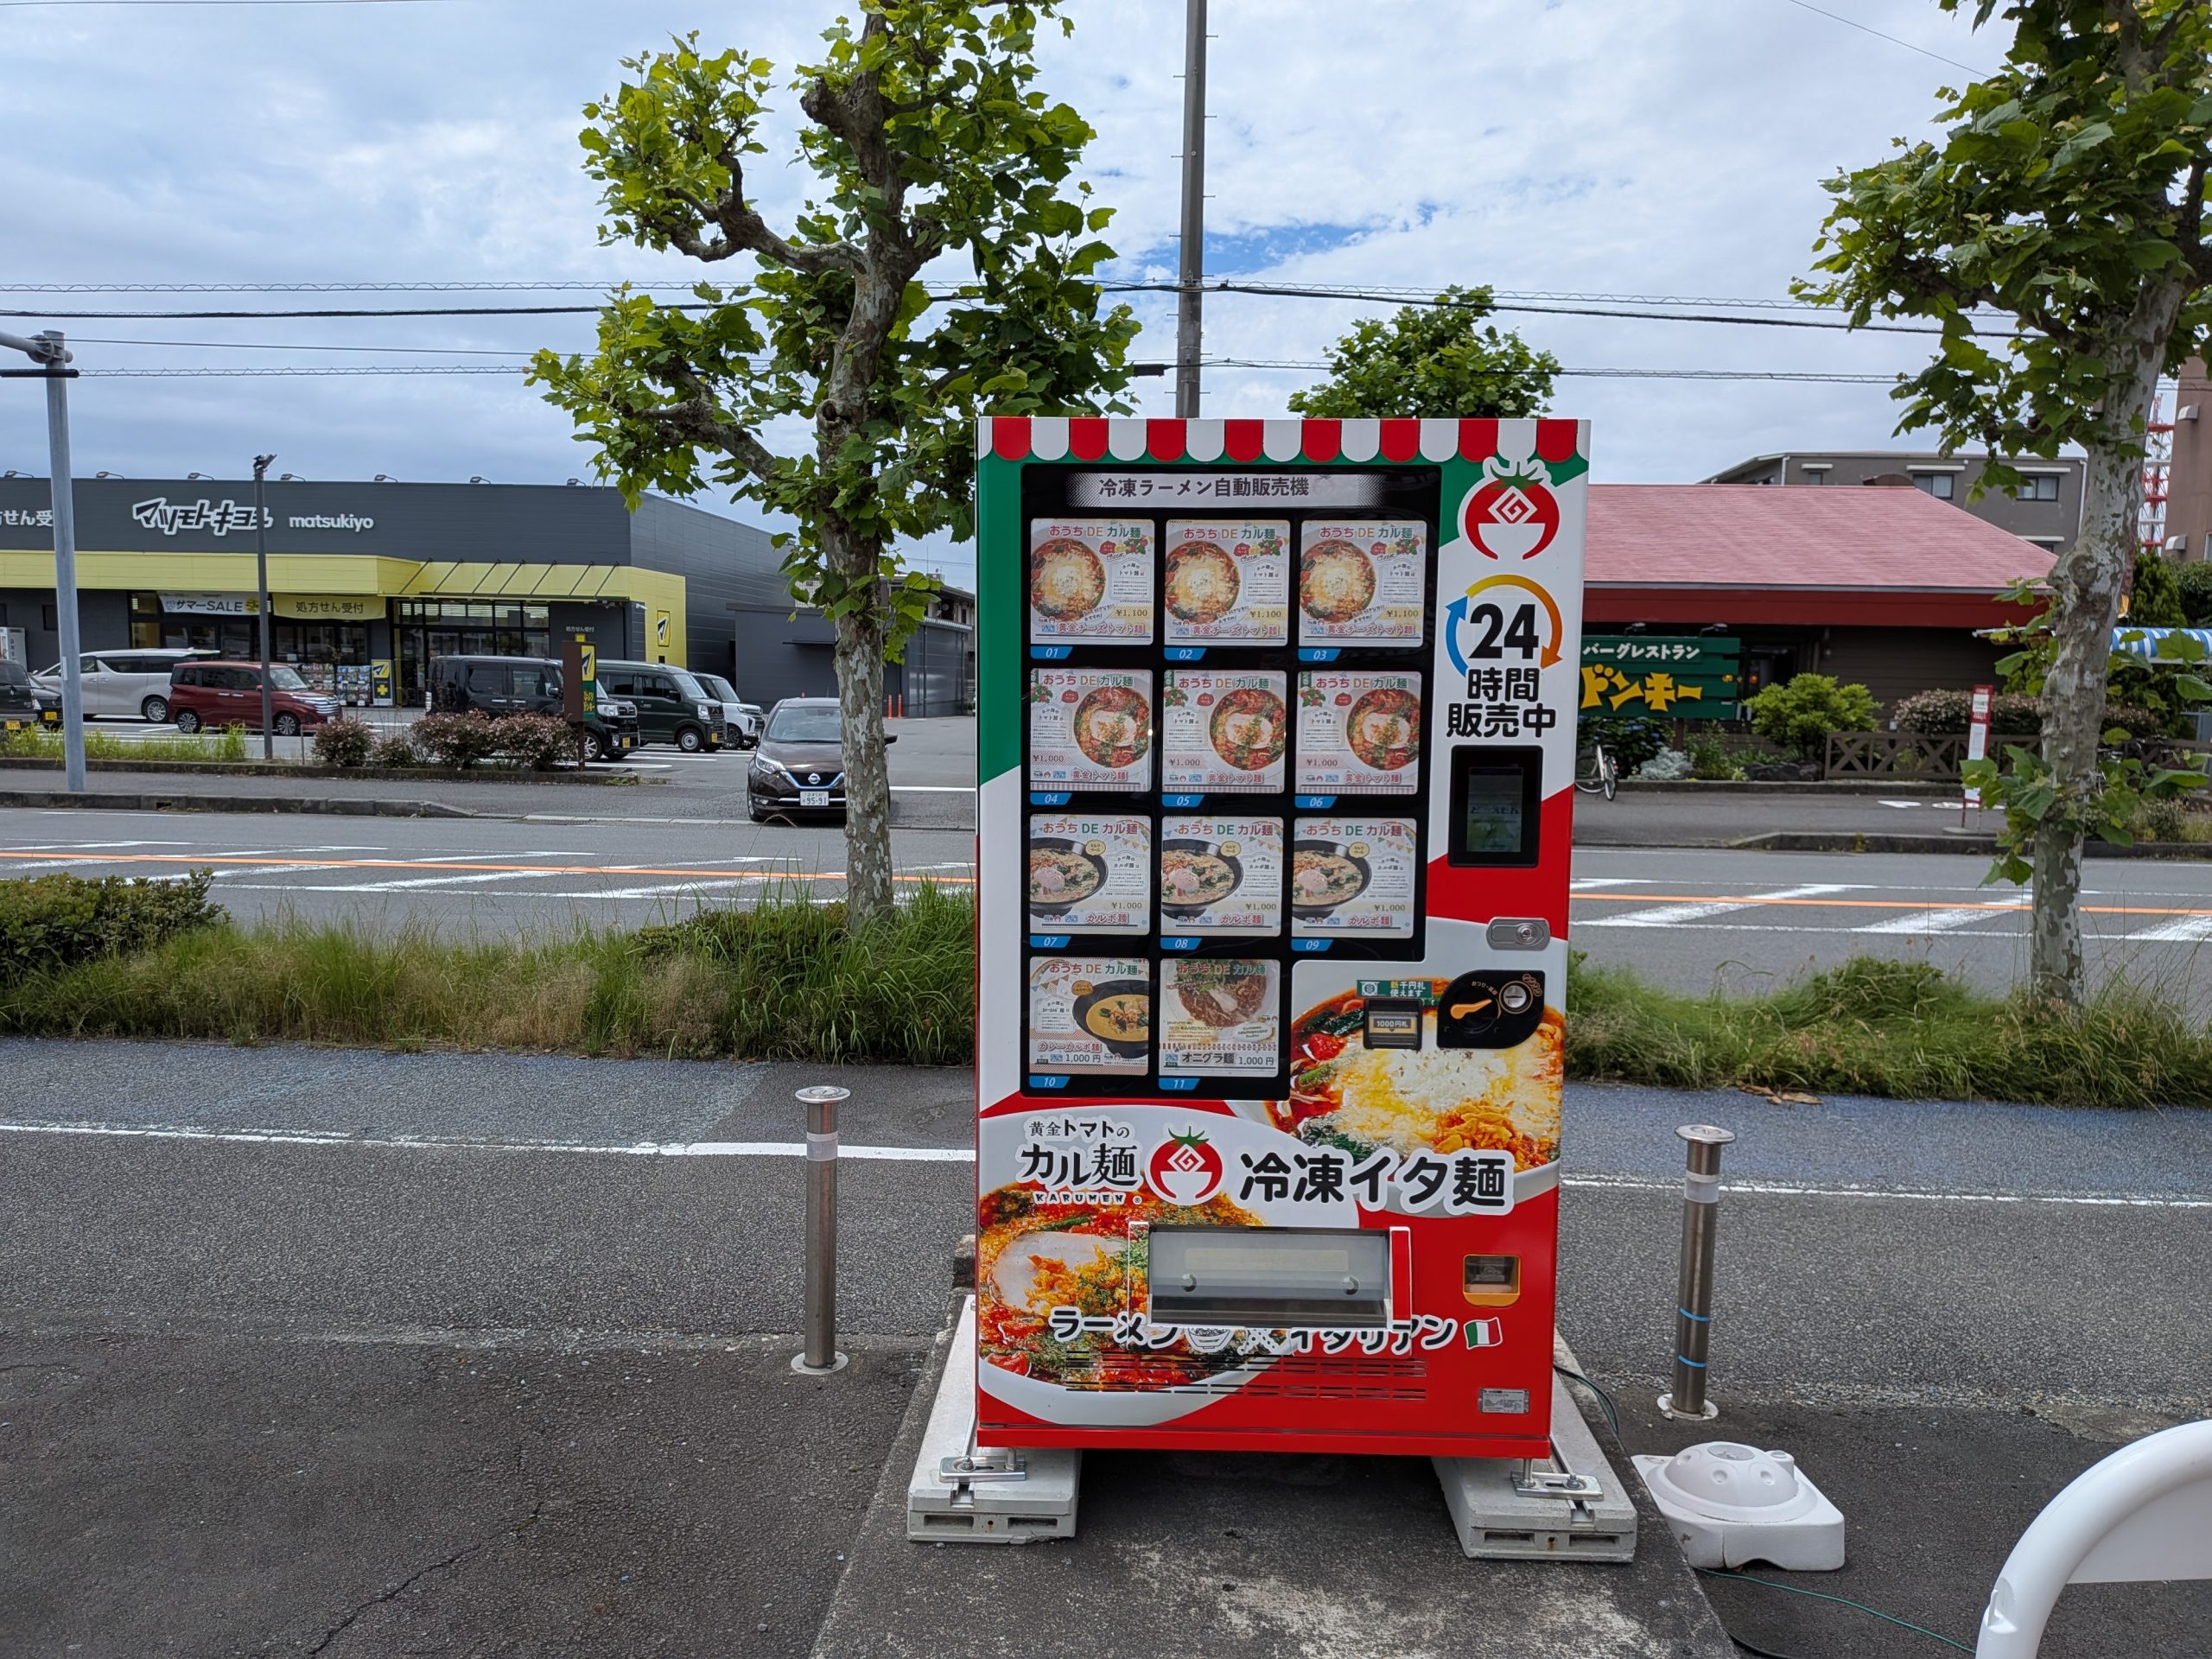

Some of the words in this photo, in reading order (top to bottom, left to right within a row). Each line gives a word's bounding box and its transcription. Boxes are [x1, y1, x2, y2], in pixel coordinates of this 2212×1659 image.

[1099, 477, 1309, 498] 冷凍ラーメン自動販売機
[289, 514, 374, 531] matsukiyo
[1050, 525, 1083, 537] おうち
[1087, 527, 1103, 537] DE
[1107, 526, 1141, 537] カル麺
[1184, 529, 1217, 539] おうち
[1221, 529, 1237, 539] DE
[1242, 529, 1275, 539] カル麺
[1320, 527, 1354, 537] おうち
[1357, 527, 1375, 537] DE
[1378, 527, 1413, 538] カル麺
[176, 600, 244, 612] サマーSALE
[296, 601, 364, 614] 処方せん受付
[1058, 623, 1145, 635] 黄金チーズトマト麺
[1192, 626, 1280, 636] 黄金チーズトマト麺
[1326, 625, 1414, 636] 黄金チーズトマト麺
[1468, 603, 1539, 660] 24
[1046, 648, 1058, 658] 01
[1179, 650, 1192, 659] 02
[1313, 651, 1327, 660] 03
[1582, 643, 1700, 660] バーグレストラン
[1044, 674, 1076, 685] おうち
[1080, 675, 1096, 685] DE
[1100, 676, 1133, 686] カル麺
[1179, 677, 1211, 688] おうち
[1216, 678, 1231, 688] DE
[1236, 678, 1269, 689] カル麺
[1316, 677, 1350, 689] おうち
[1353, 678, 1370, 688] DE
[1374, 677, 1408, 689] カル麺
[1467, 667, 1540, 702] 時間
[1580, 664, 1703, 712] ドンキー
[1446, 702, 1556, 738] 販売中
[1071, 770, 1128, 781] 黄金トマト麺
[1207, 774, 1264, 785] 黄金トマト麺
[1344, 773, 1401, 784] 黄金トマト麺
[1045, 794, 1058, 804] 04
[1176, 797, 1190, 806] 05
[1310, 798, 1323, 808] 06
[1043, 823, 1077, 834] おうち
[1082, 823, 1099, 834] DE
[1103, 823, 1138, 835] カル麺
[1178, 824, 1213, 835] おうち
[1217, 824, 1235, 835] DE
[1237, 824, 1273, 836] カル麺
[1306, 825, 1341, 836] おうち
[1345, 825, 1363, 836] DE
[1366, 825, 1402, 836] カル麺
[1086, 913, 1128, 925] カルボ麺
[1220, 915, 1263, 925] カルボ麺
[1349, 917, 1391, 926] カルボ麺
[1044, 938, 1057, 946] 07
[1175, 939, 1188, 949] 08
[1306, 940, 1319, 950] 09
[1050, 963, 1082, 973] おうち
[1085, 964, 1102, 974] DE
[1105, 964, 1138, 975] カル麺
[1178, 964, 1211, 975] おうち
[1214, 965, 1230, 975] DE
[1390, 981, 1427, 989] 新千円札
[1039, 1043, 1102, 1052] カレーカルボ麺
[1065, 1054, 1090, 1063] 1,000
[1092, 1054, 1101, 1063] 円
[1182, 1052, 1235, 1065] オニグラ麺
[1239, 1057, 1263, 1065] 1,000
[1266, 1057, 1274, 1065] 円
[1044, 1077, 1056, 1086] 10
[1173, 1079, 1185, 1089] 11
[1029, 1119, 1130, 1138] 黄金トマトの
[1020, 1143, 1138, 1186] カル麺
[1240, 1152, 1506, 1207] 冷凍イタ麺
[1035, 1193, 1126, 1204] KARUMEN
